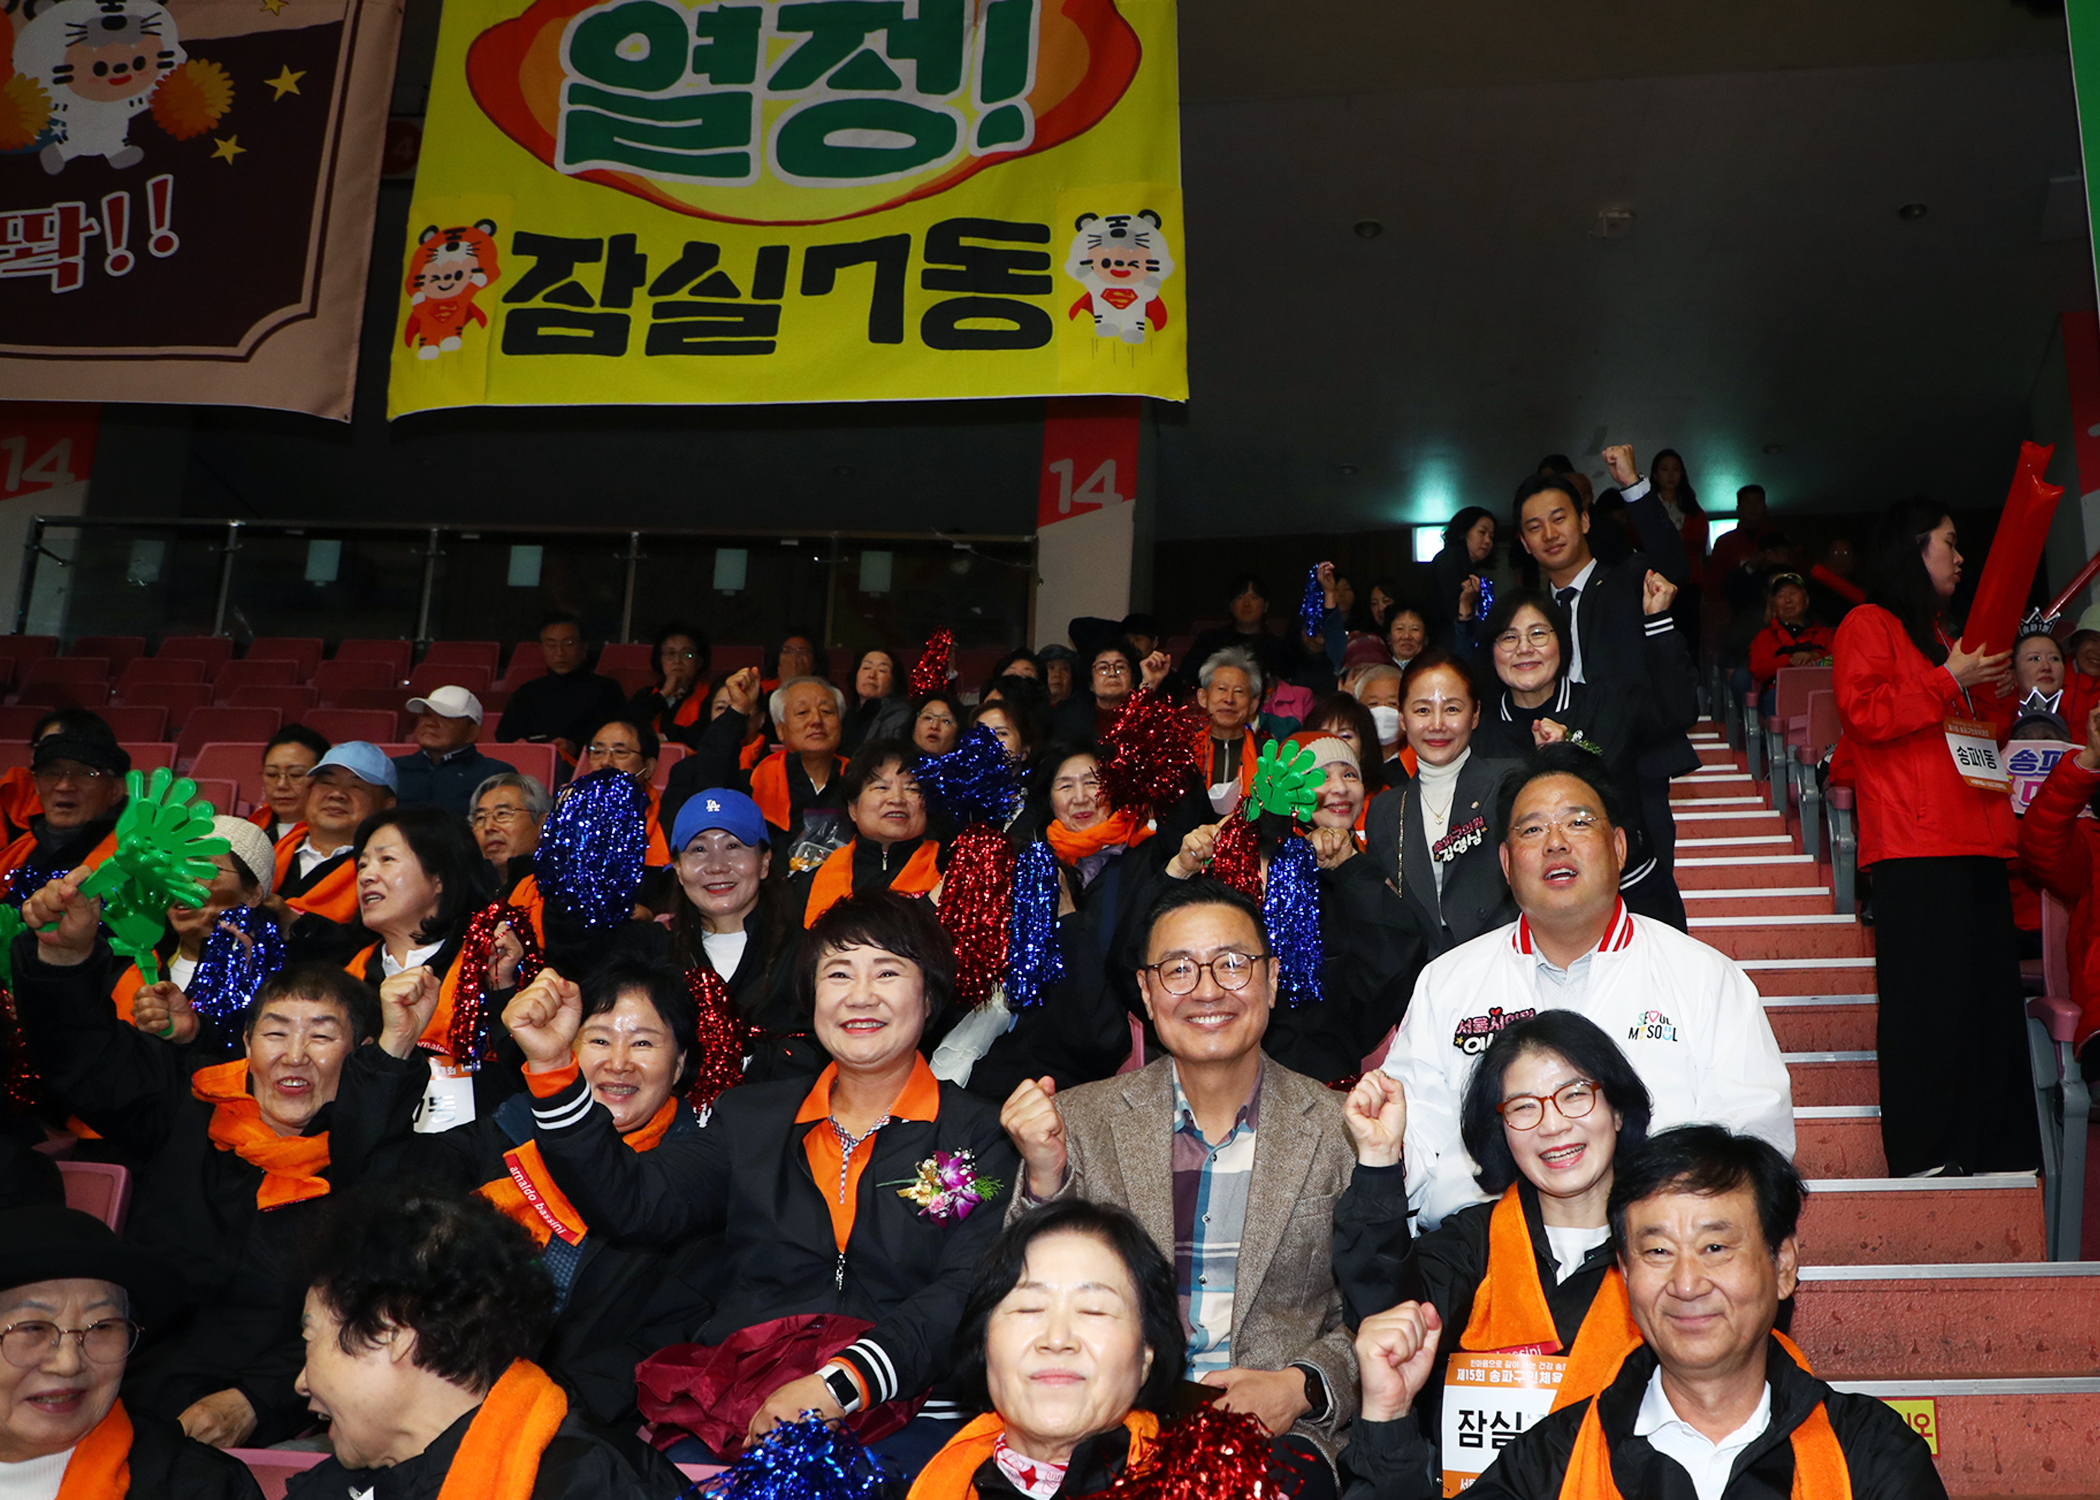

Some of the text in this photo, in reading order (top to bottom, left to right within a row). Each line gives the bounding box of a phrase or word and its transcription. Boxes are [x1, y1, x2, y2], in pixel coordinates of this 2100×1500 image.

[555, 0, 1038, 186] 열정!
[501, 217, 1054, 357] 잠실7동
[1, 435, 77, 492] 14
[1048, 457, 1124, 514] 14
[1956, 745, 1997, 770] 송파1동
[706, 799, 721, 812] LA
[509, 1165, 567, 1235] arnaldo bassini
[1456, 1368, 1486, 1382] 제15회
[1457, 1409, 1546, 1450] 잠실
